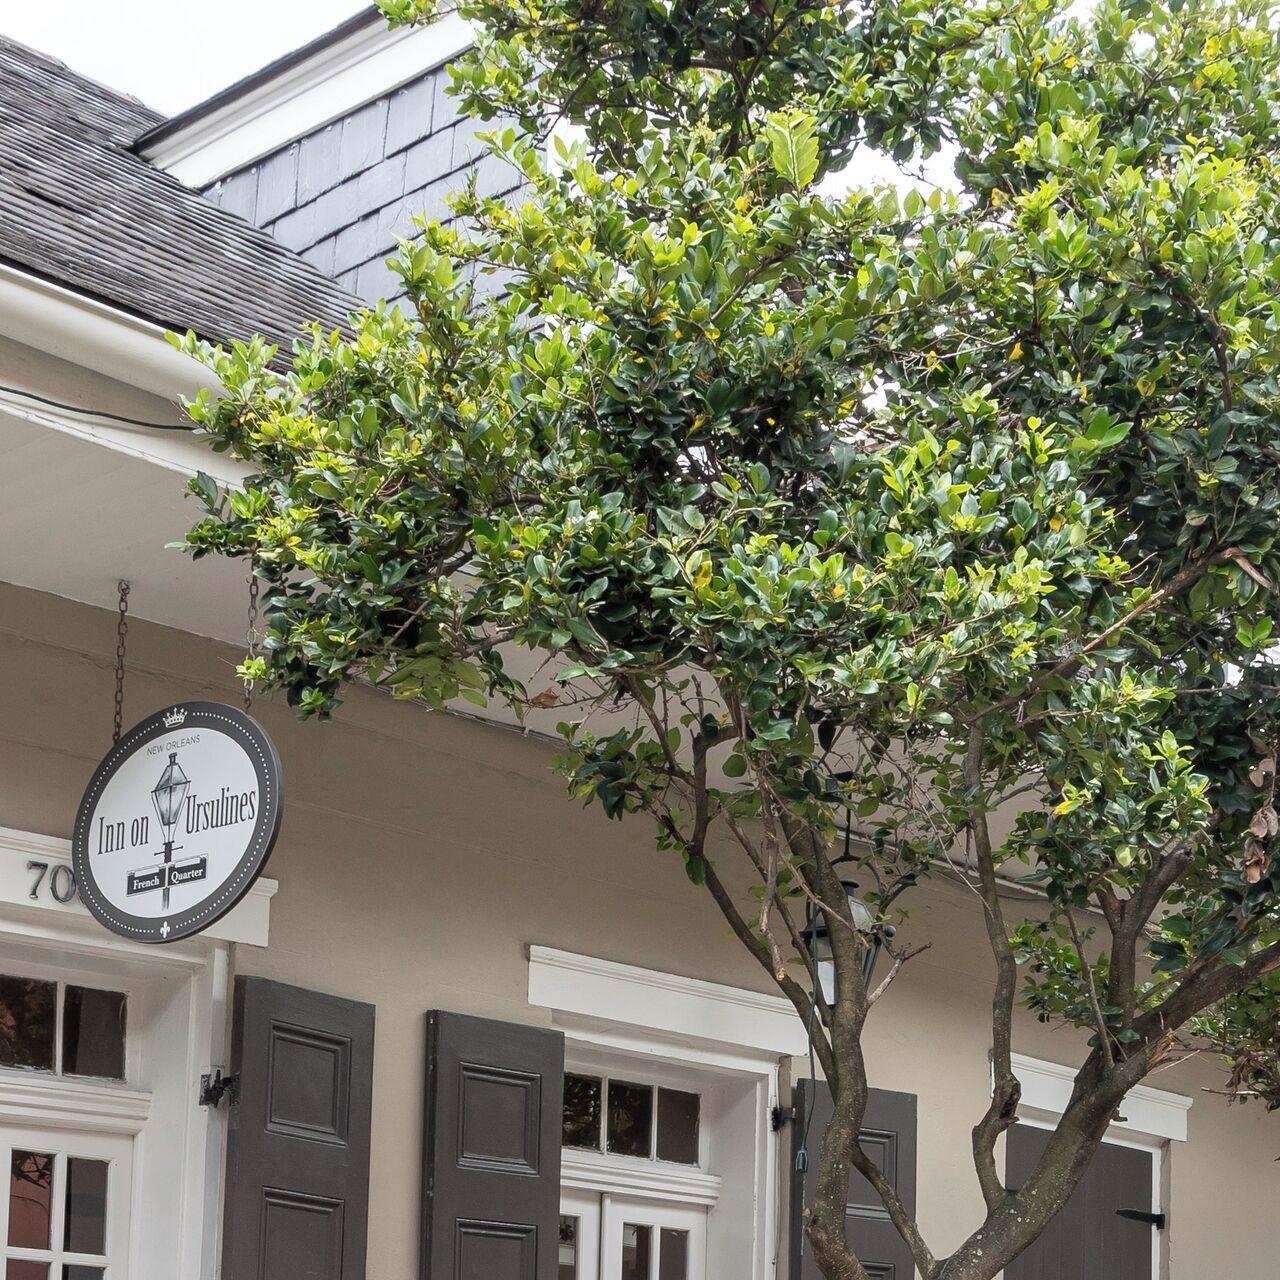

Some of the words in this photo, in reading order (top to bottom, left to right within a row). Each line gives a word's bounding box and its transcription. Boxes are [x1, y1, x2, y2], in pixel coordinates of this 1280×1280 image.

[147, 744, 165, 756] NEW
[166, 734, 200, 751] ORLEANS
[97, 816, 125, 855] Inn
[130, 815, 149, 847] on
[186, 786, 256, 834] Ursulines
[26, 860, 80, 904] 70
[133, 875, 160, 890] French
[171, 868, 203, 884] Quarter
